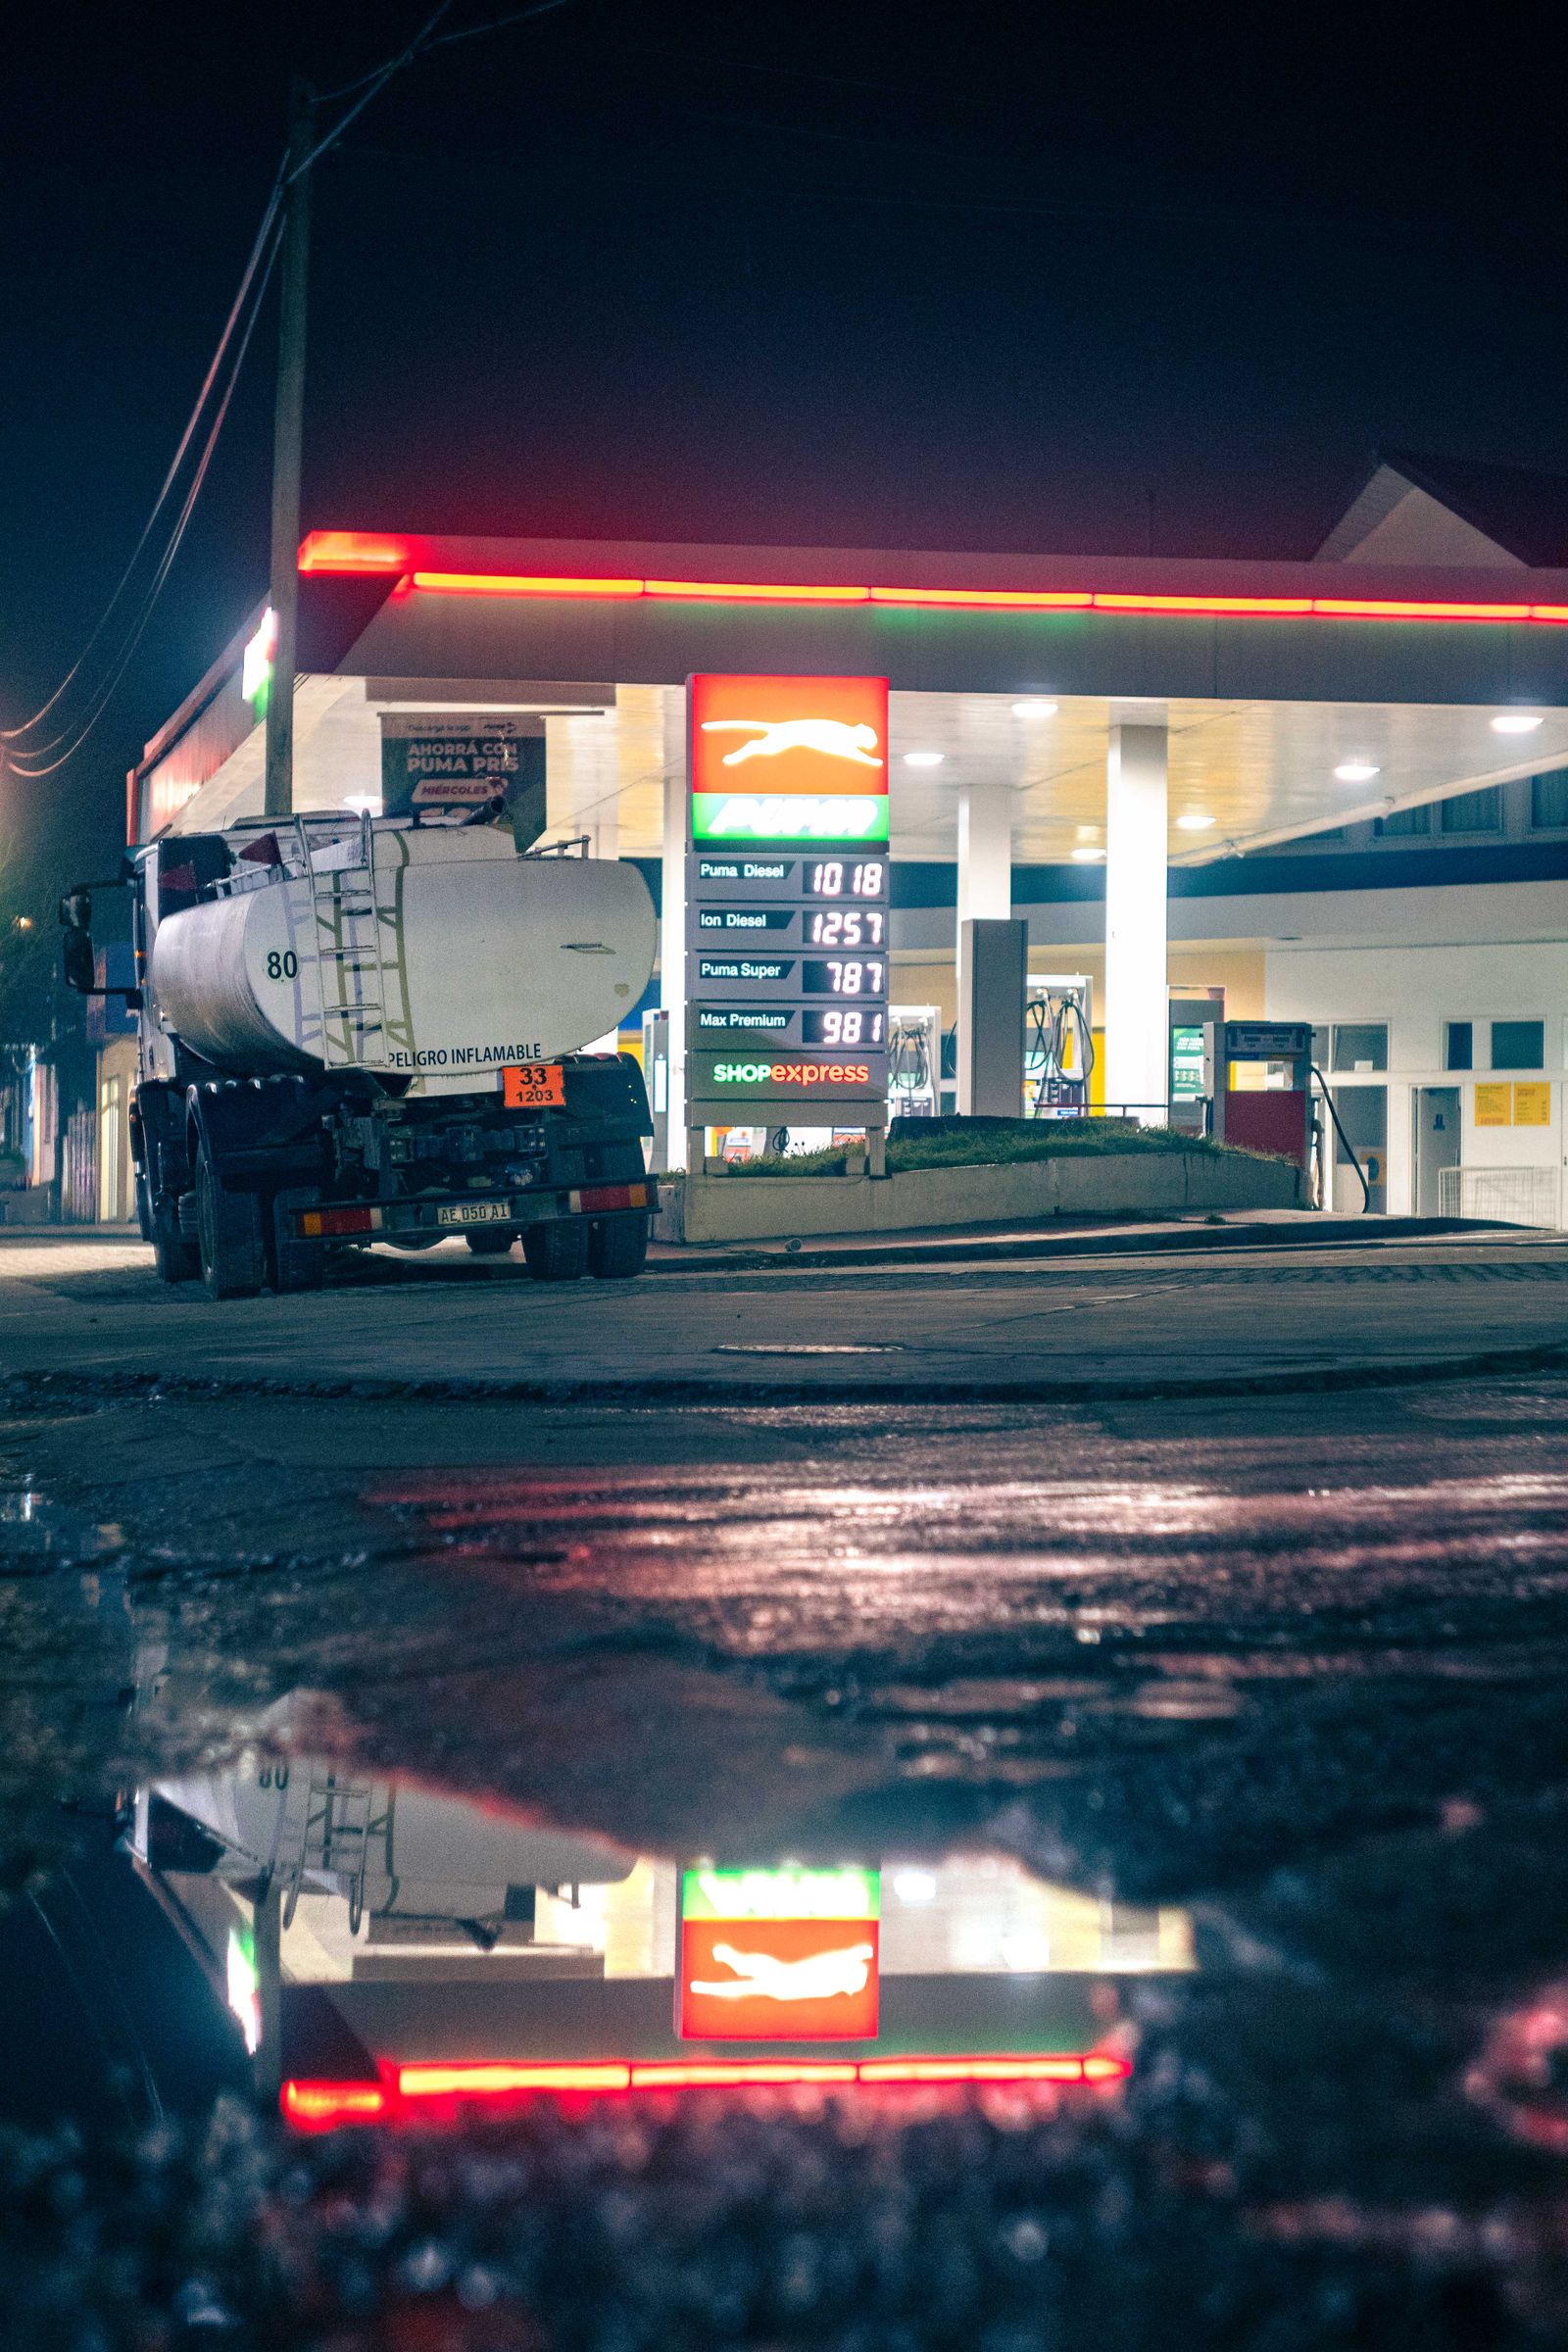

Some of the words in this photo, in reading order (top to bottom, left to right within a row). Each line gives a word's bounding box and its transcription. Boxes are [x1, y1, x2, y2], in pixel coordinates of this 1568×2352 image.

[408, 739, 478, 756] AHORRÁ
[407, 758, 468, 772] PUMA
[472, 756, 518, 771] PRIS
[421, 783, 488, 796] MIÉRCOLES
[700, 863, 738, 878] Puma
[743, 863, 784, 878] Diesel
[812, 862, 883, 896] 1018
[701, 912, 721, 927] Ion
[726, 913, 766, 927] Diesel
[812, 911, 883, 945] 1257
[267, 950, 298, 980] 80
[701, 962, 739, 977] Puma
[740, 962, 781, 980] Super
[826, 961, 883, 994] 787
[700, 1013, 727, 1027] Max
[729, 1012, 786, 1027] Premium
[823, 1011, 883, 1043] 981
[388, 1049, 448, 1068] PELIGRO
[451, 1043, 542, 1064] INFLAMABLE
[519, 1067, 548, 1086] 33
[515, 1089, 554, 1102] 1203
[441, 1208, 458, 1223] AE
